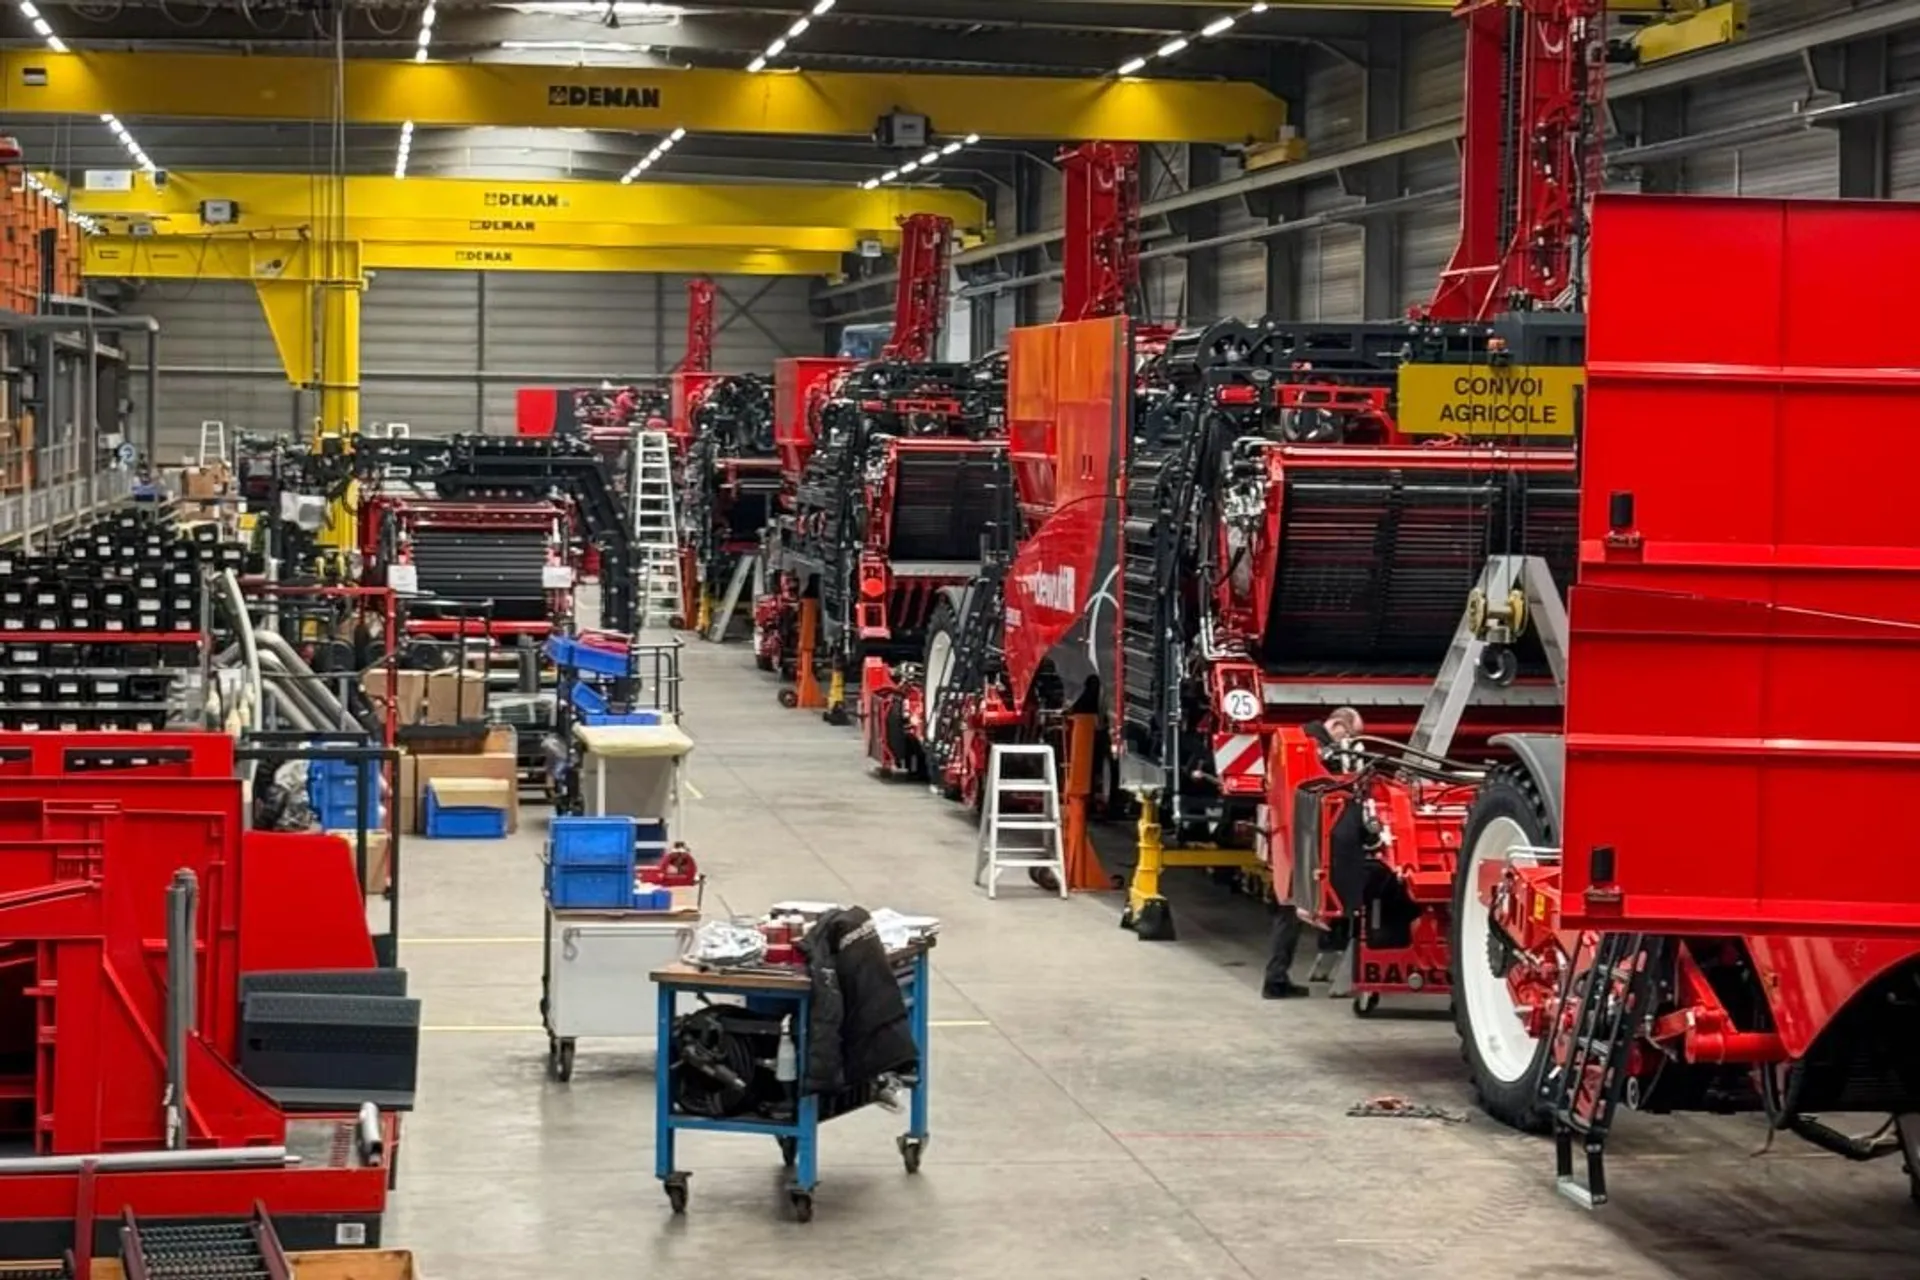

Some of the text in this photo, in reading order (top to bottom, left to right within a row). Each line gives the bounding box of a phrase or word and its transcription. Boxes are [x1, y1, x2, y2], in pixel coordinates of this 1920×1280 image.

[569, 86, 660, 108] DEMAN
[499, 193, 559, 207] DEMAN
[1454, 376, 1543, 397] CONVOI
[1439, 403, 1558, 424] AGRICOLE
[1231, 693, 1253, 716] 25
